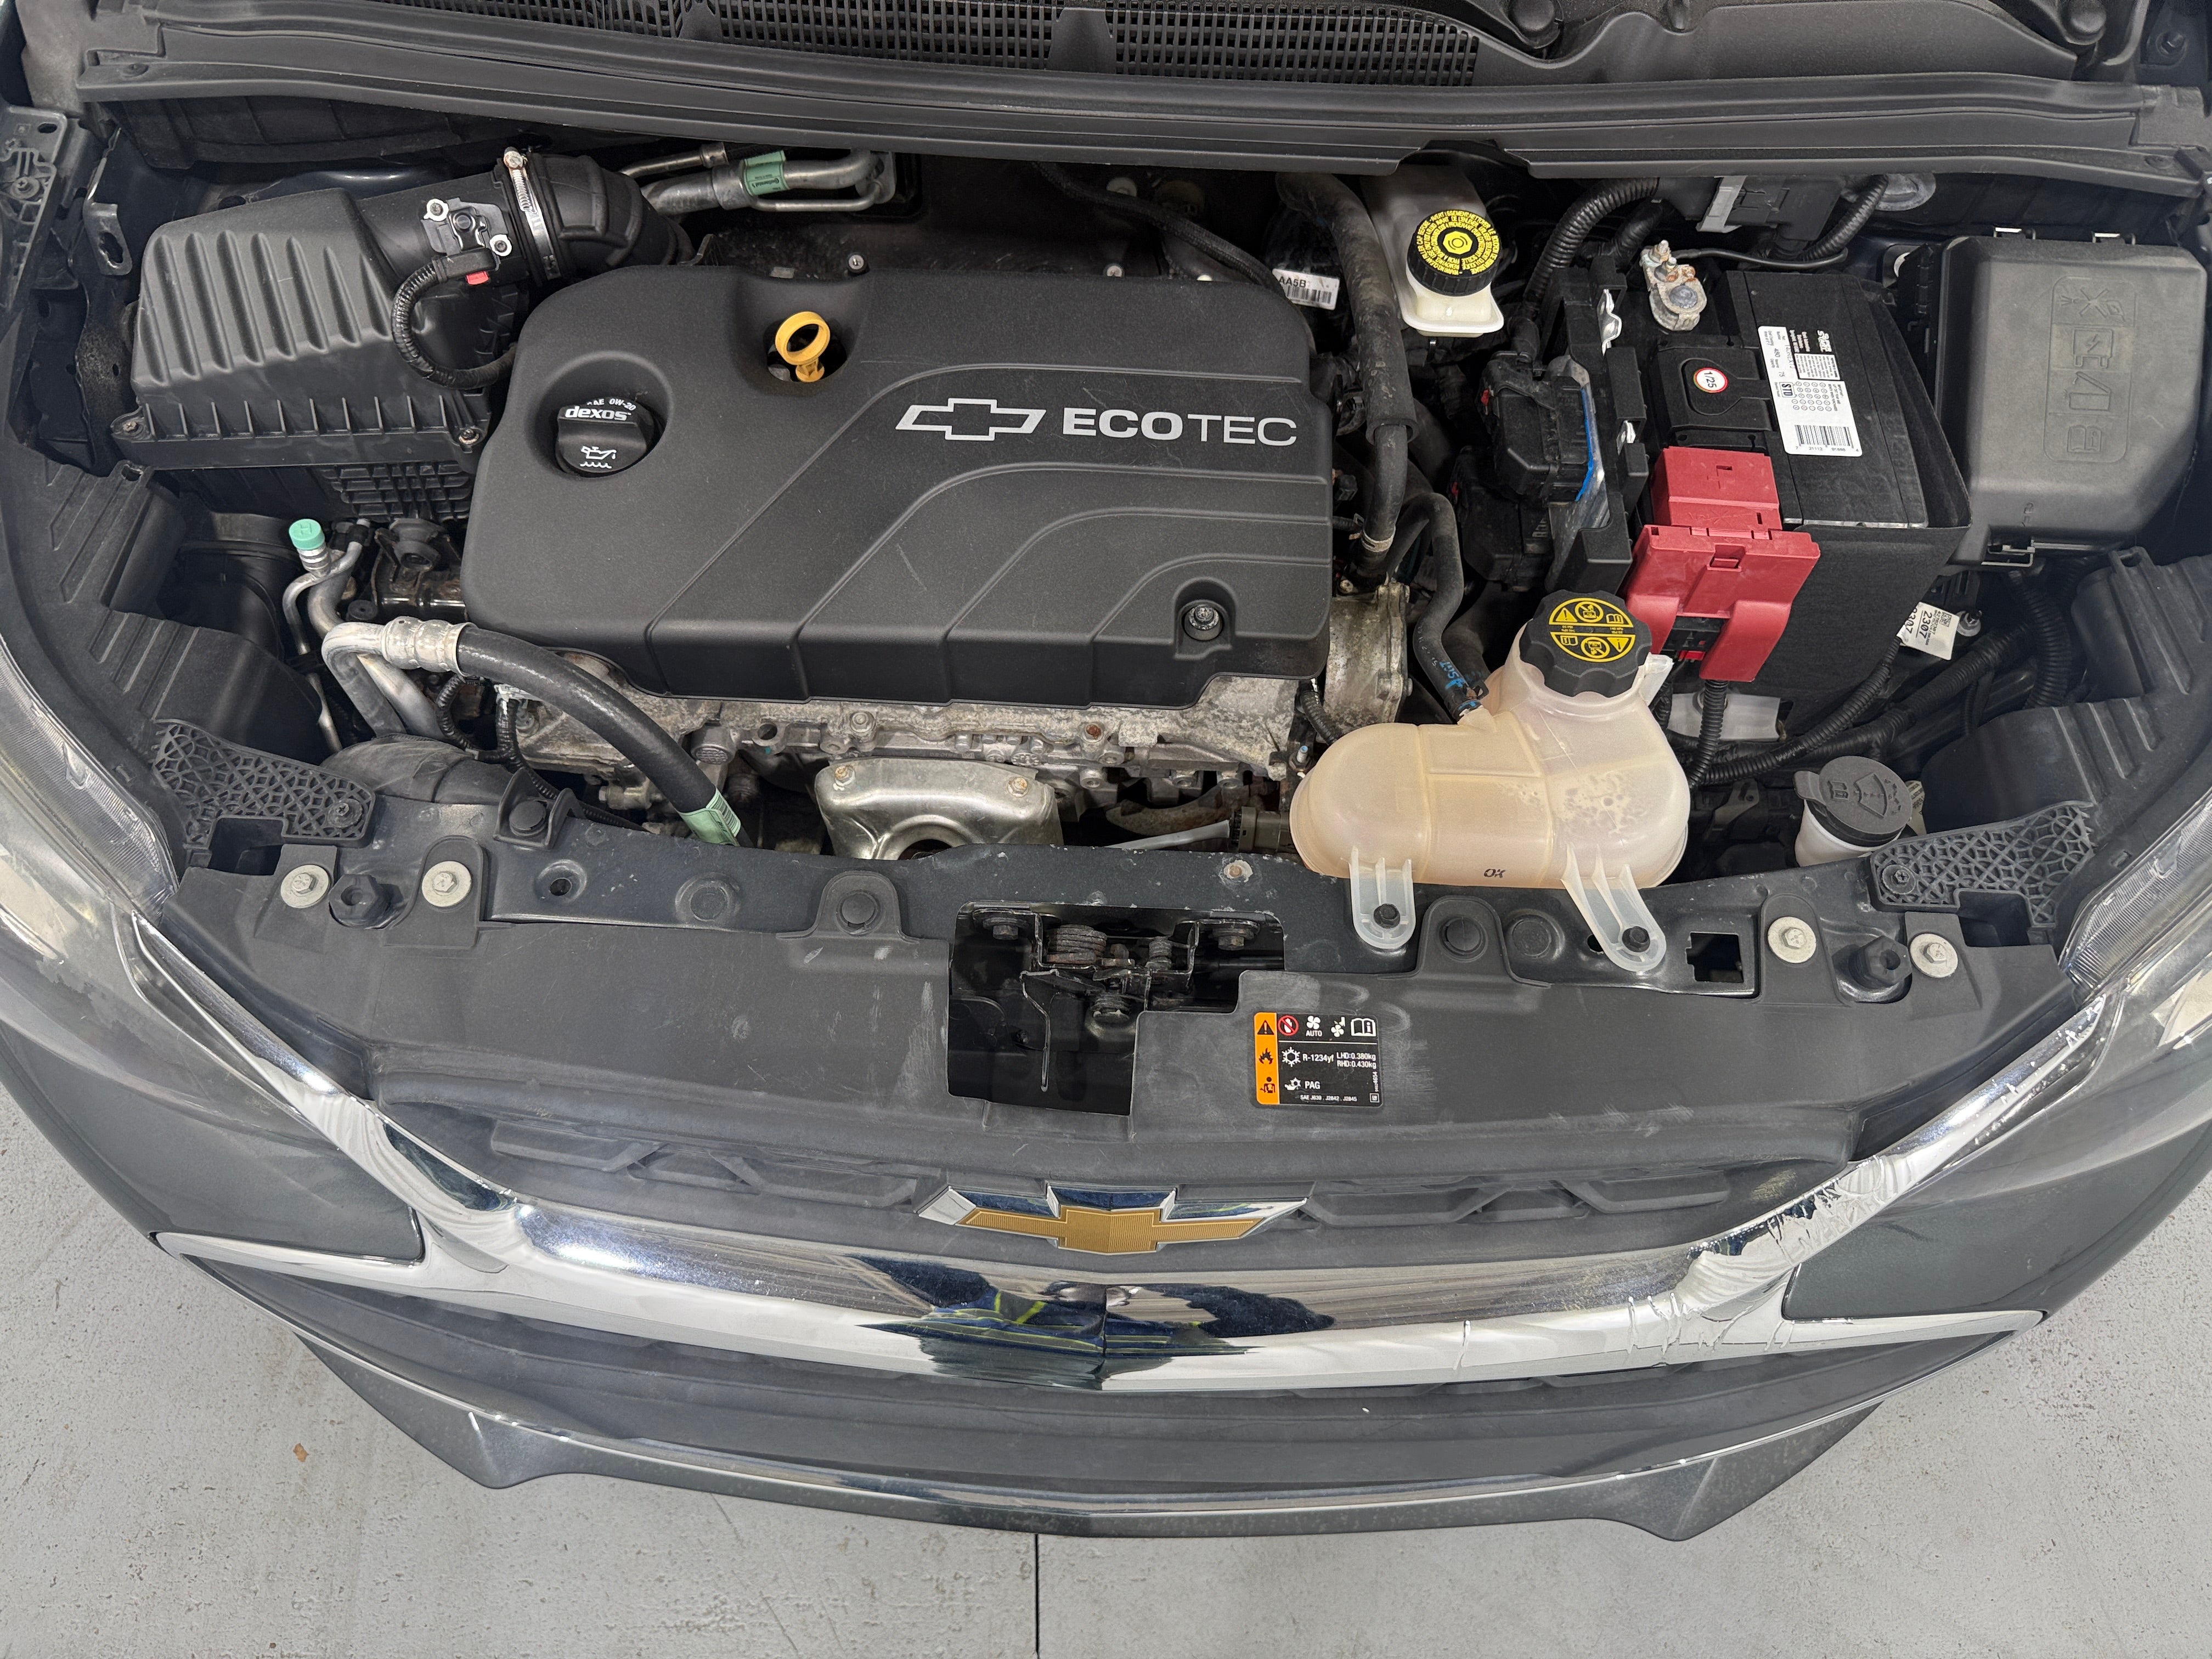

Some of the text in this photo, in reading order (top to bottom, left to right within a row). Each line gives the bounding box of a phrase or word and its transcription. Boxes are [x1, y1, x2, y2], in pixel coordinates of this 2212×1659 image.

[1702, 371, 1718, 390] 1/25
[1781, 383, 1793, 396] STD
[609, 398, 637, 411] 0W-20
[565, 406, 628, 421] dexos
[1062, 408, 1297, 446] ECOTEC
[1919, 610, 1932, 639] 2307
[1483, 868, 1506, 878] OK
[1302, 1053, 1334, 1063] R-1234yf
[1337, 1060, 1376, 1069] RHD:0.430kg
[1305, 1081, 1321, 1090] PAG
